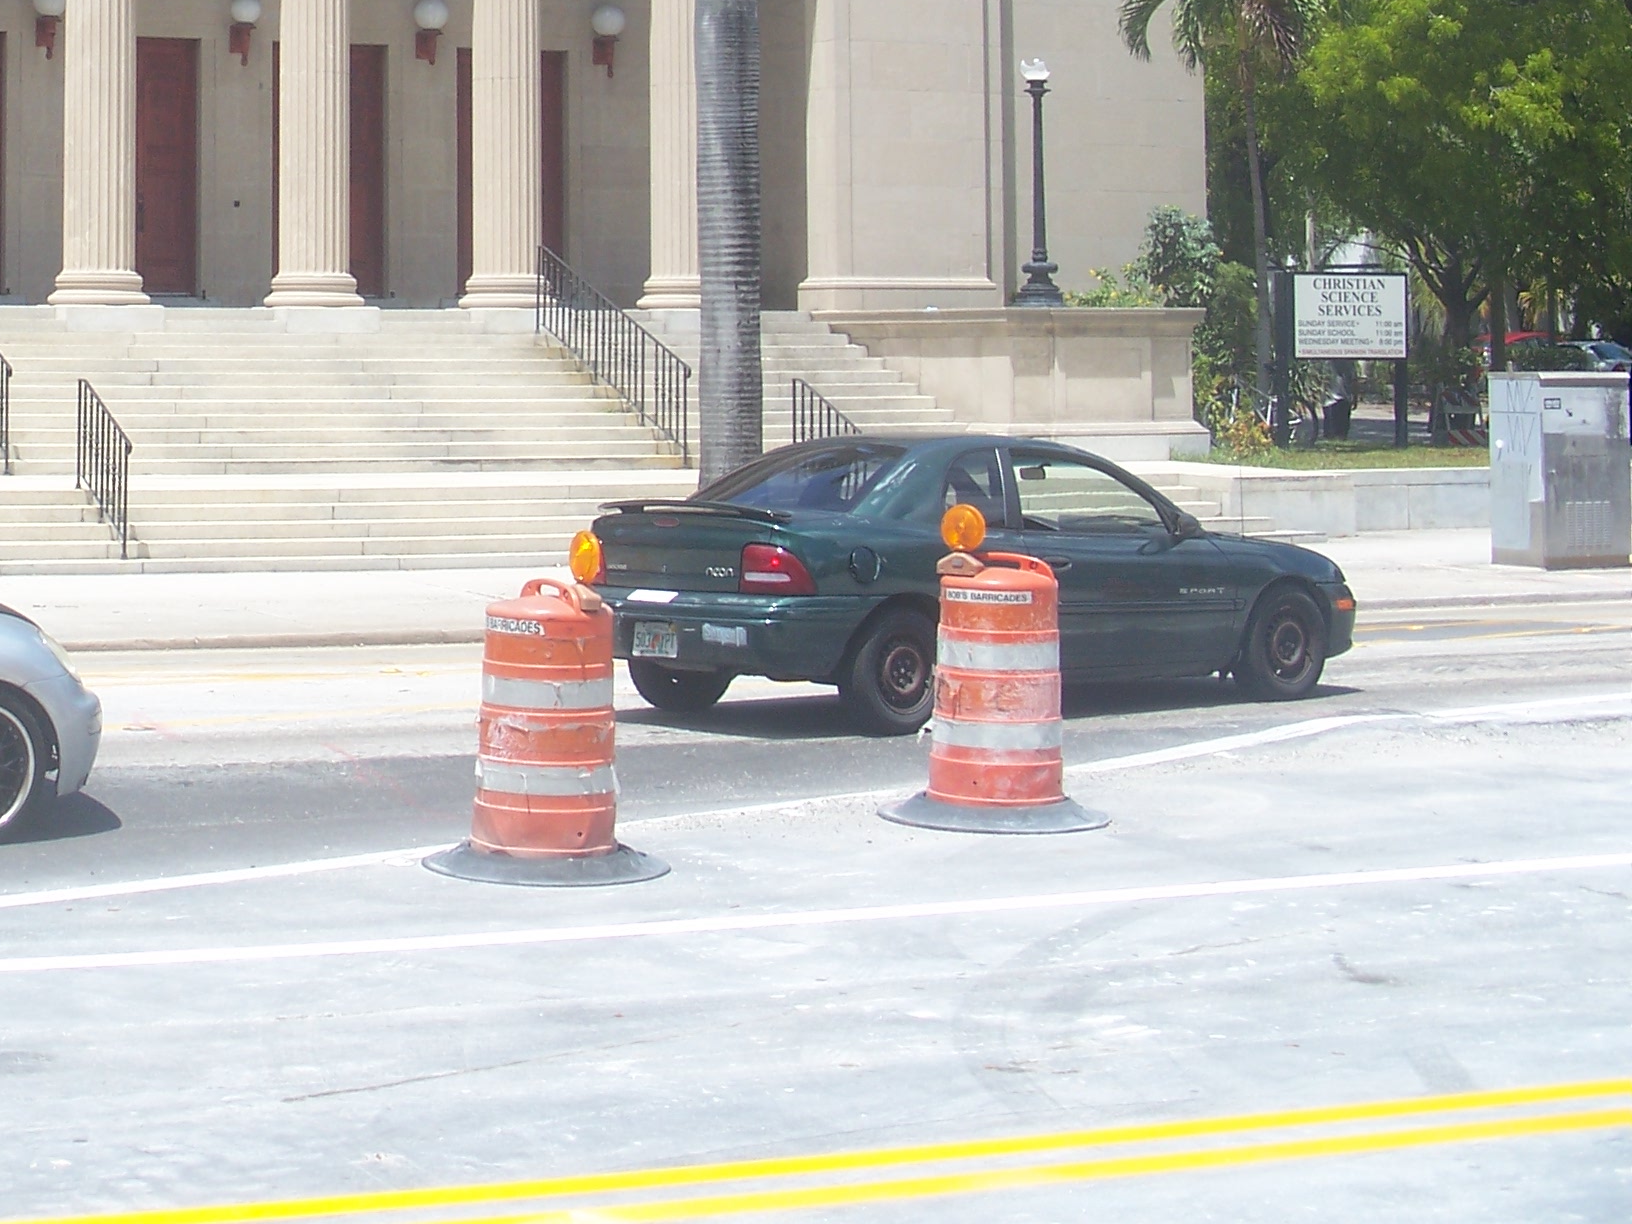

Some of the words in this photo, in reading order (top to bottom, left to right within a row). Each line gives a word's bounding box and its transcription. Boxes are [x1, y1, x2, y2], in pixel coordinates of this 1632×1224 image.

[1312, 278, 1386, 290] CHRISTIAN
[1321, 291, 1379, 303] SCIENCE
[1317, 304, 1382, 316] SERVICES
[970, 592, 1027, 602] BARRICADES
[1179, 587, 1225, 595] SPORT
